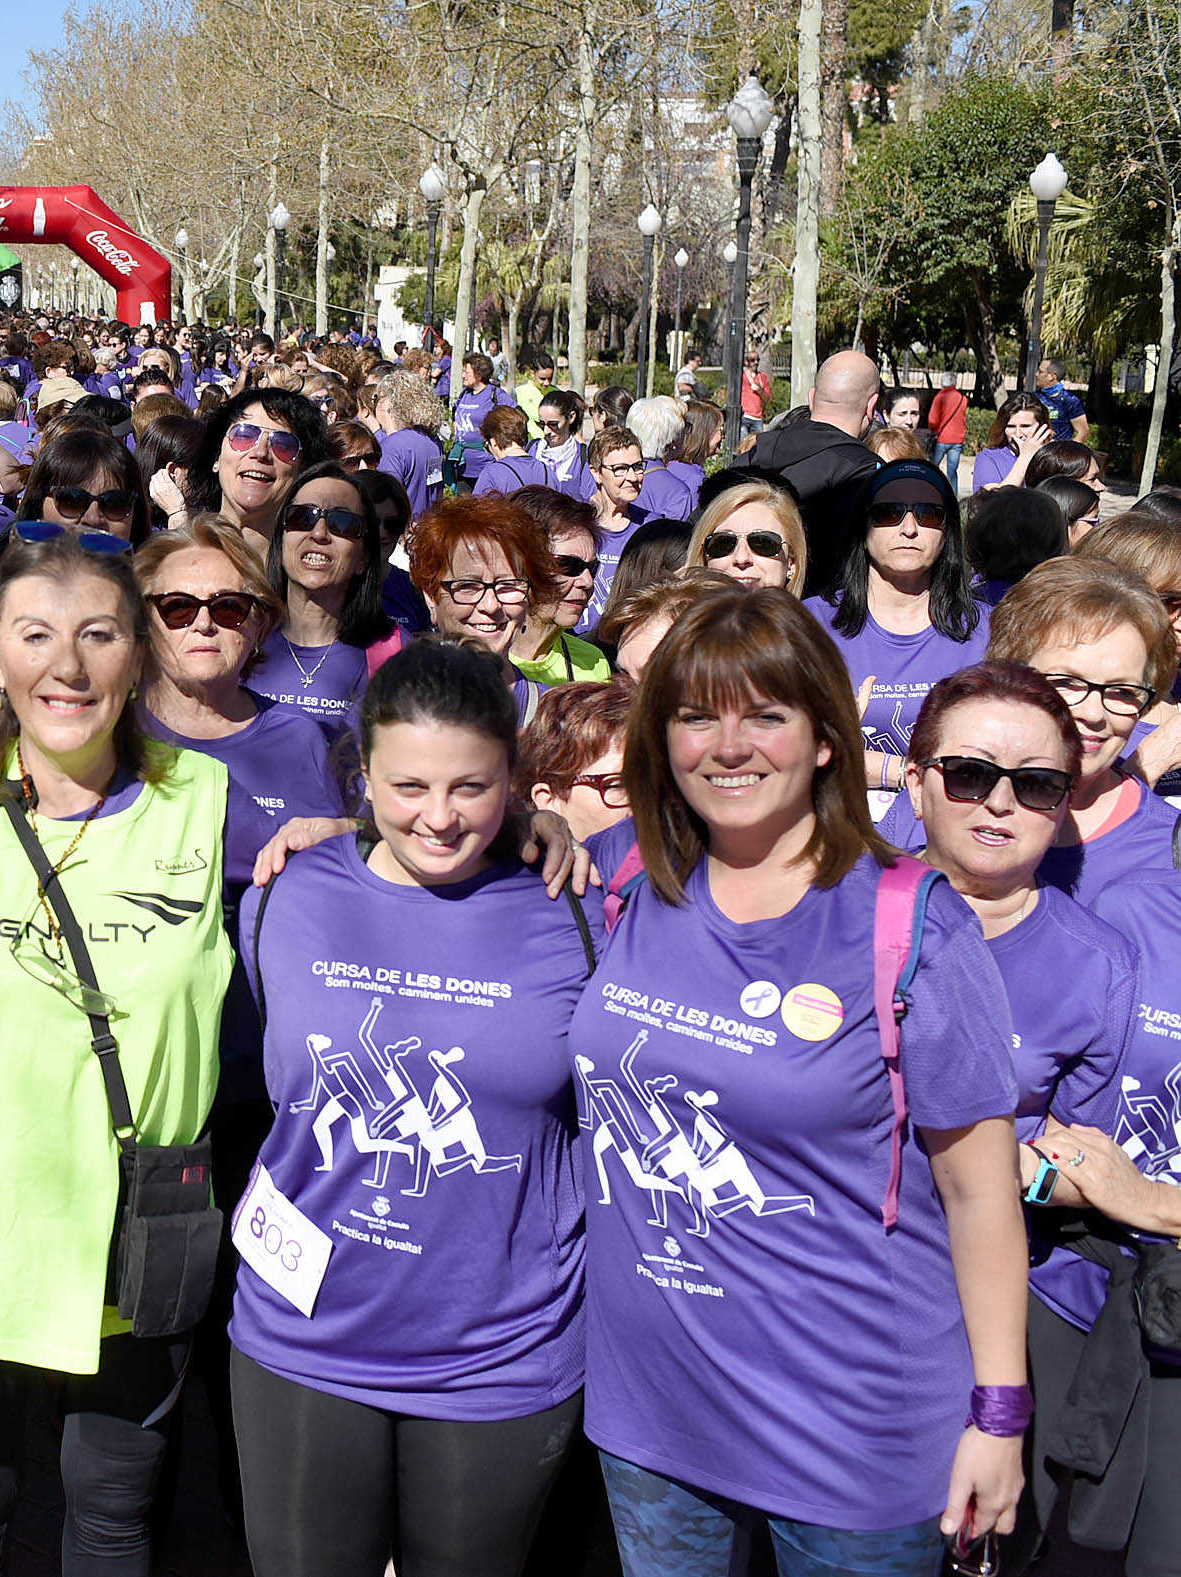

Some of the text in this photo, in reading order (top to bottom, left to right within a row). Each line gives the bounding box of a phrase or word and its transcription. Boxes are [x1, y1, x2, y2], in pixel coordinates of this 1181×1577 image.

[86, 230, 140, 277] Coca-Cola
[279, 694, 294, 704] DE
[297, 695, 318, 706] LES
[894, 684, 908, 693] DE
[909, 682, 930, 691] LES
[311, 960, 512, 999] CURSA DE LES DONES
[324, 976, 494, 1008] Som moltes, caminem unides
[601, 982, 649, 1010] CURSA
[651, 997, 677, 1016] DE
[675, 1004, 710, 1028] LES
[709, 1015, 778, 1047] DONES
[603, 1000, 754, 1055] Som moltes, caminem unides
[1143, 1021, 1169, 1037] Som
[250, 1206, 302, 1272] 803
[332, 1220, 422, 1255] Practica la igualtat
[671, 1277, 682, 1289] la
[683, 1280, 724, 1297] igualtat
